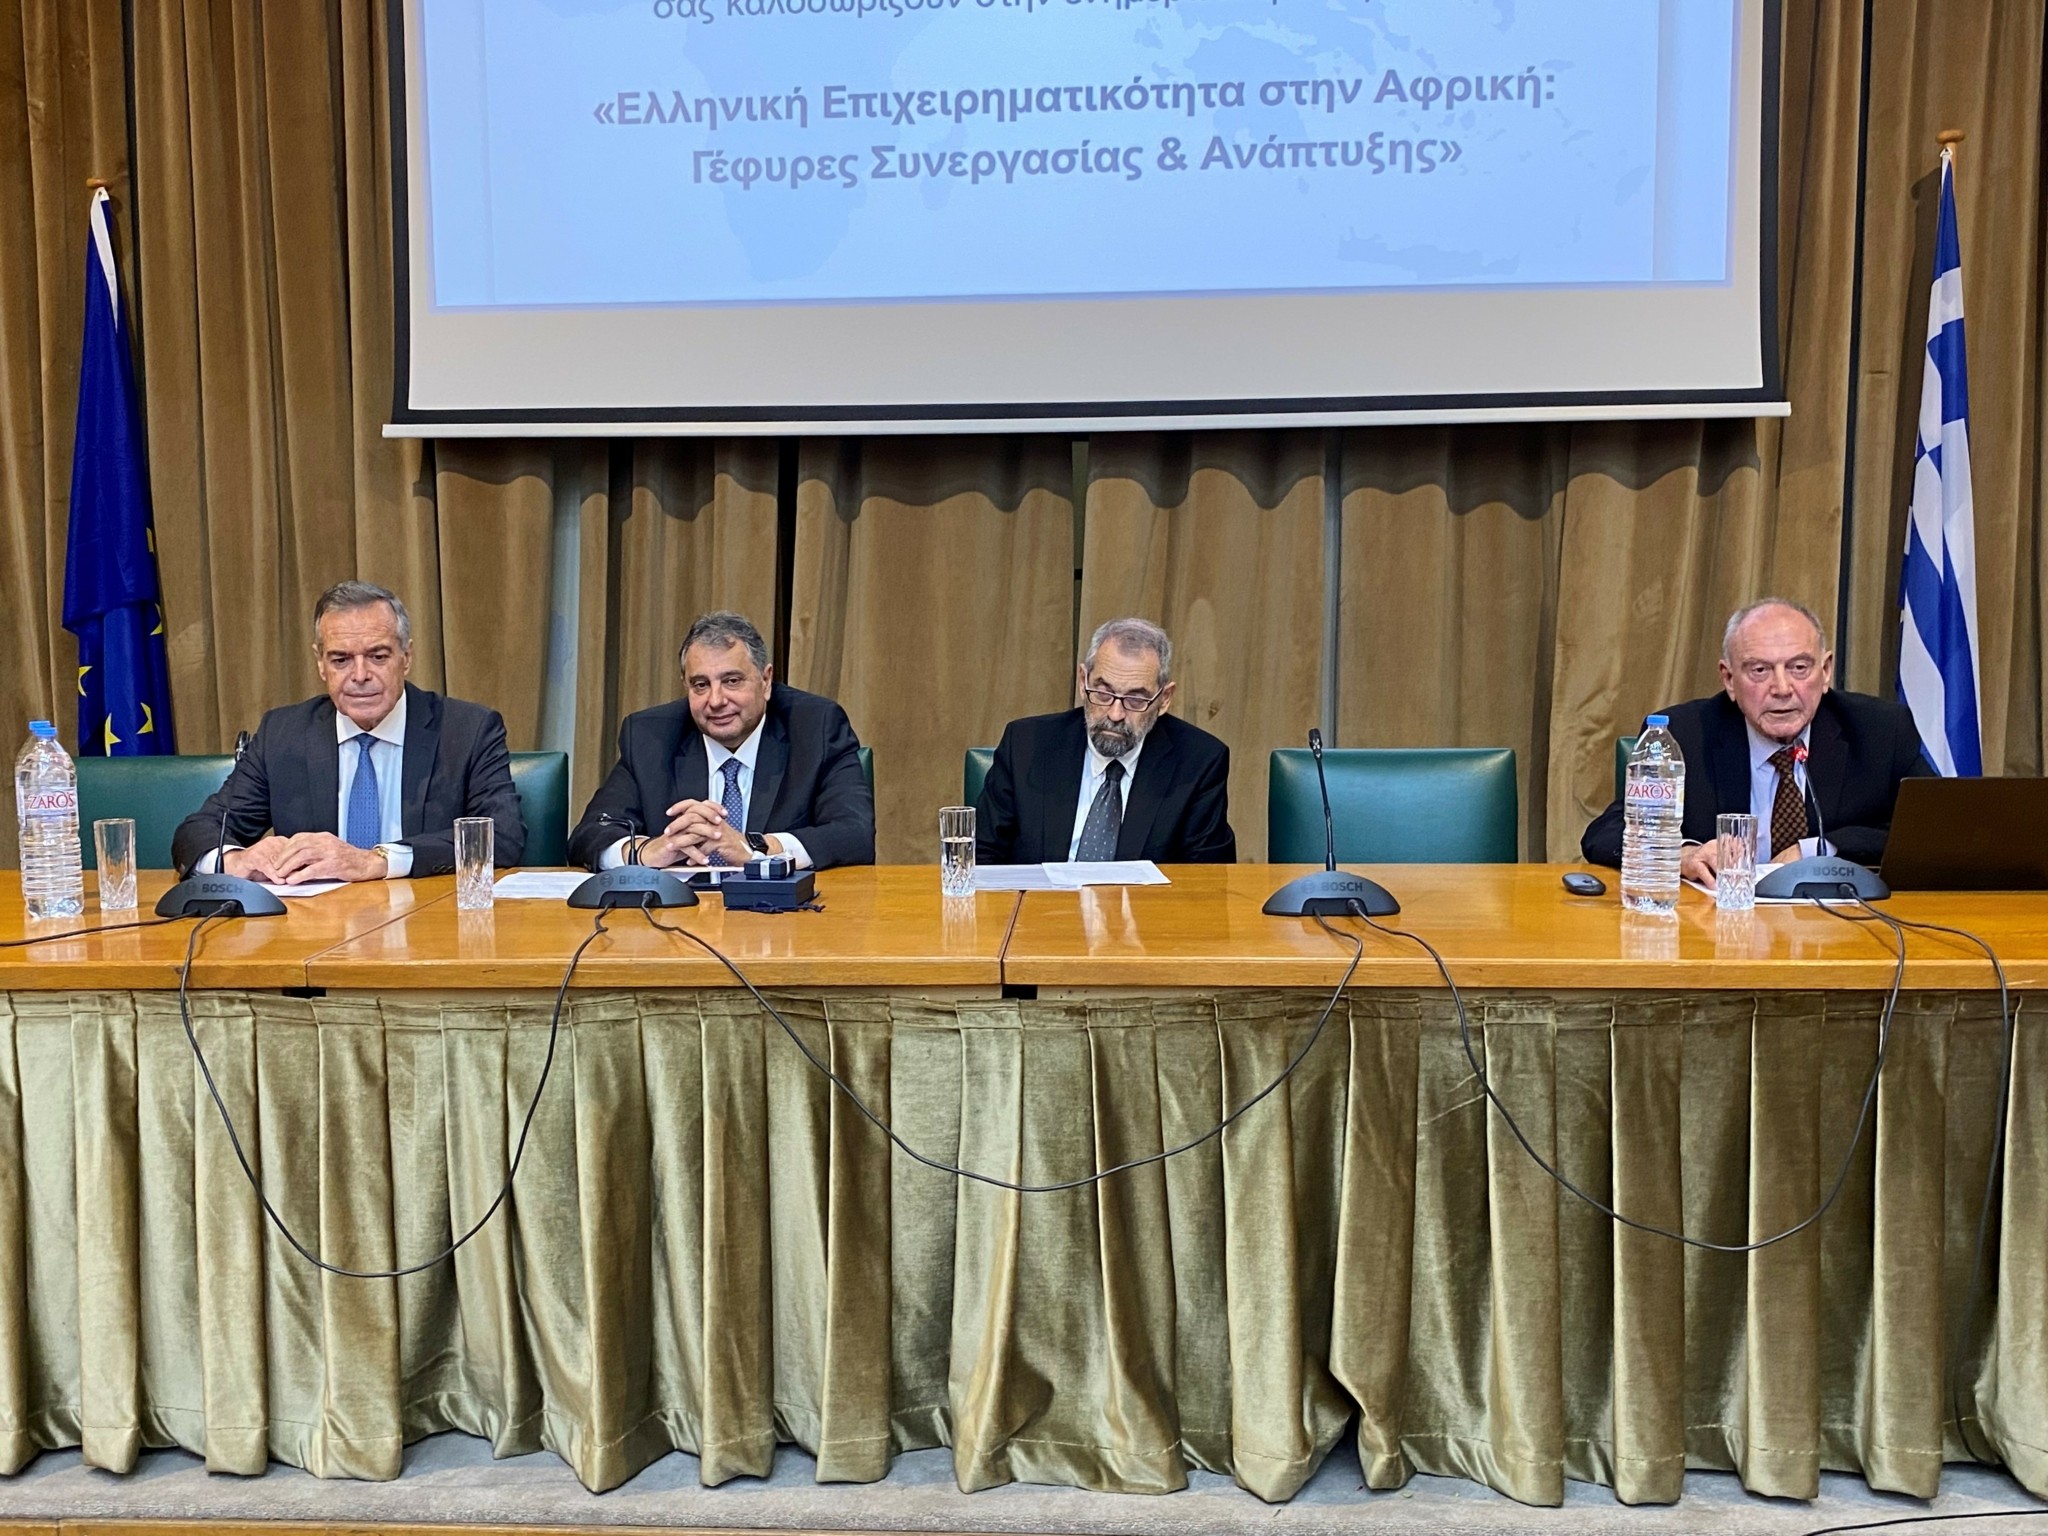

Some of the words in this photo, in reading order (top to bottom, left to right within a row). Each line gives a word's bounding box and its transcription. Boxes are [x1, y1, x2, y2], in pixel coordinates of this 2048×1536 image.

[593, 86, 809, 130] «Ελληνική
[823, 74, 1246, 126] Επιχειρηματικότητα
[1259, 78, 1363, 114] στην
[1373, 65, 1556, 112] Αφρική:
[693, 148, 859, 191] Γέφυρες
[871, 138, 1144, 185] Συνεργασίας
[1156, 136, 1189, 172] &
[1199, 131, 1463, 175] Ανάπτυξης»
[1812, 866, 1855, 877] BOSCH
[619, 875, 660, 885] BOSCH
[202, 883, 243, 893] BOSCH
[1321, 881, 1363, 892] BOSCH
